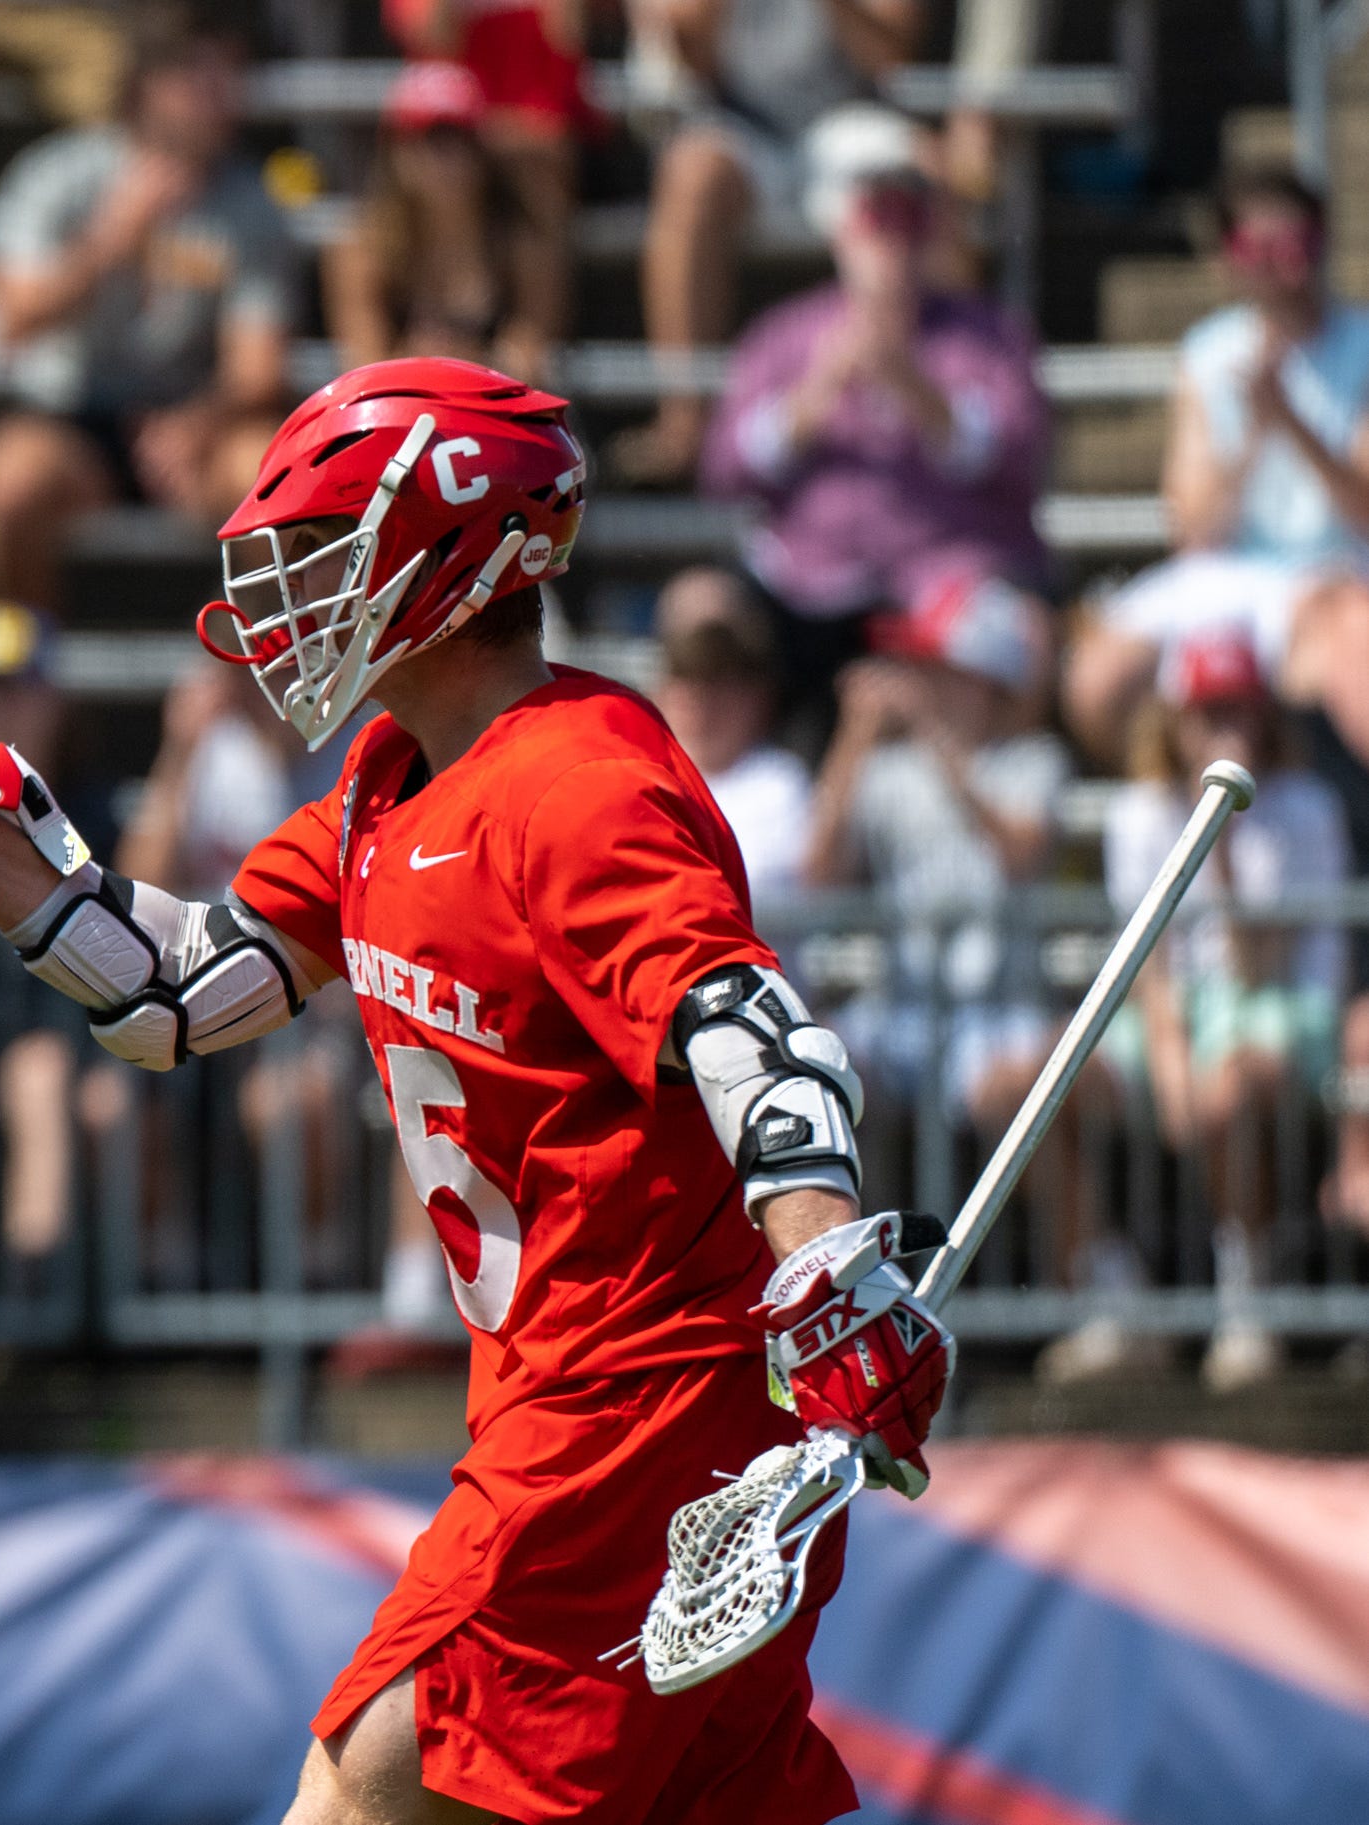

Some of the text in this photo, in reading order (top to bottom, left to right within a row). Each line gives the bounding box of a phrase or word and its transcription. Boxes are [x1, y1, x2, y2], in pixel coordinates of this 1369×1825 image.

[431, 436, 490, 505] C
[385, 1043, 521, 1333] 5
[879, 1221, 894, 1260] C
[774, 1250, 837, 1304] CORNELL
[792, 1287, 869, 1361] STX
